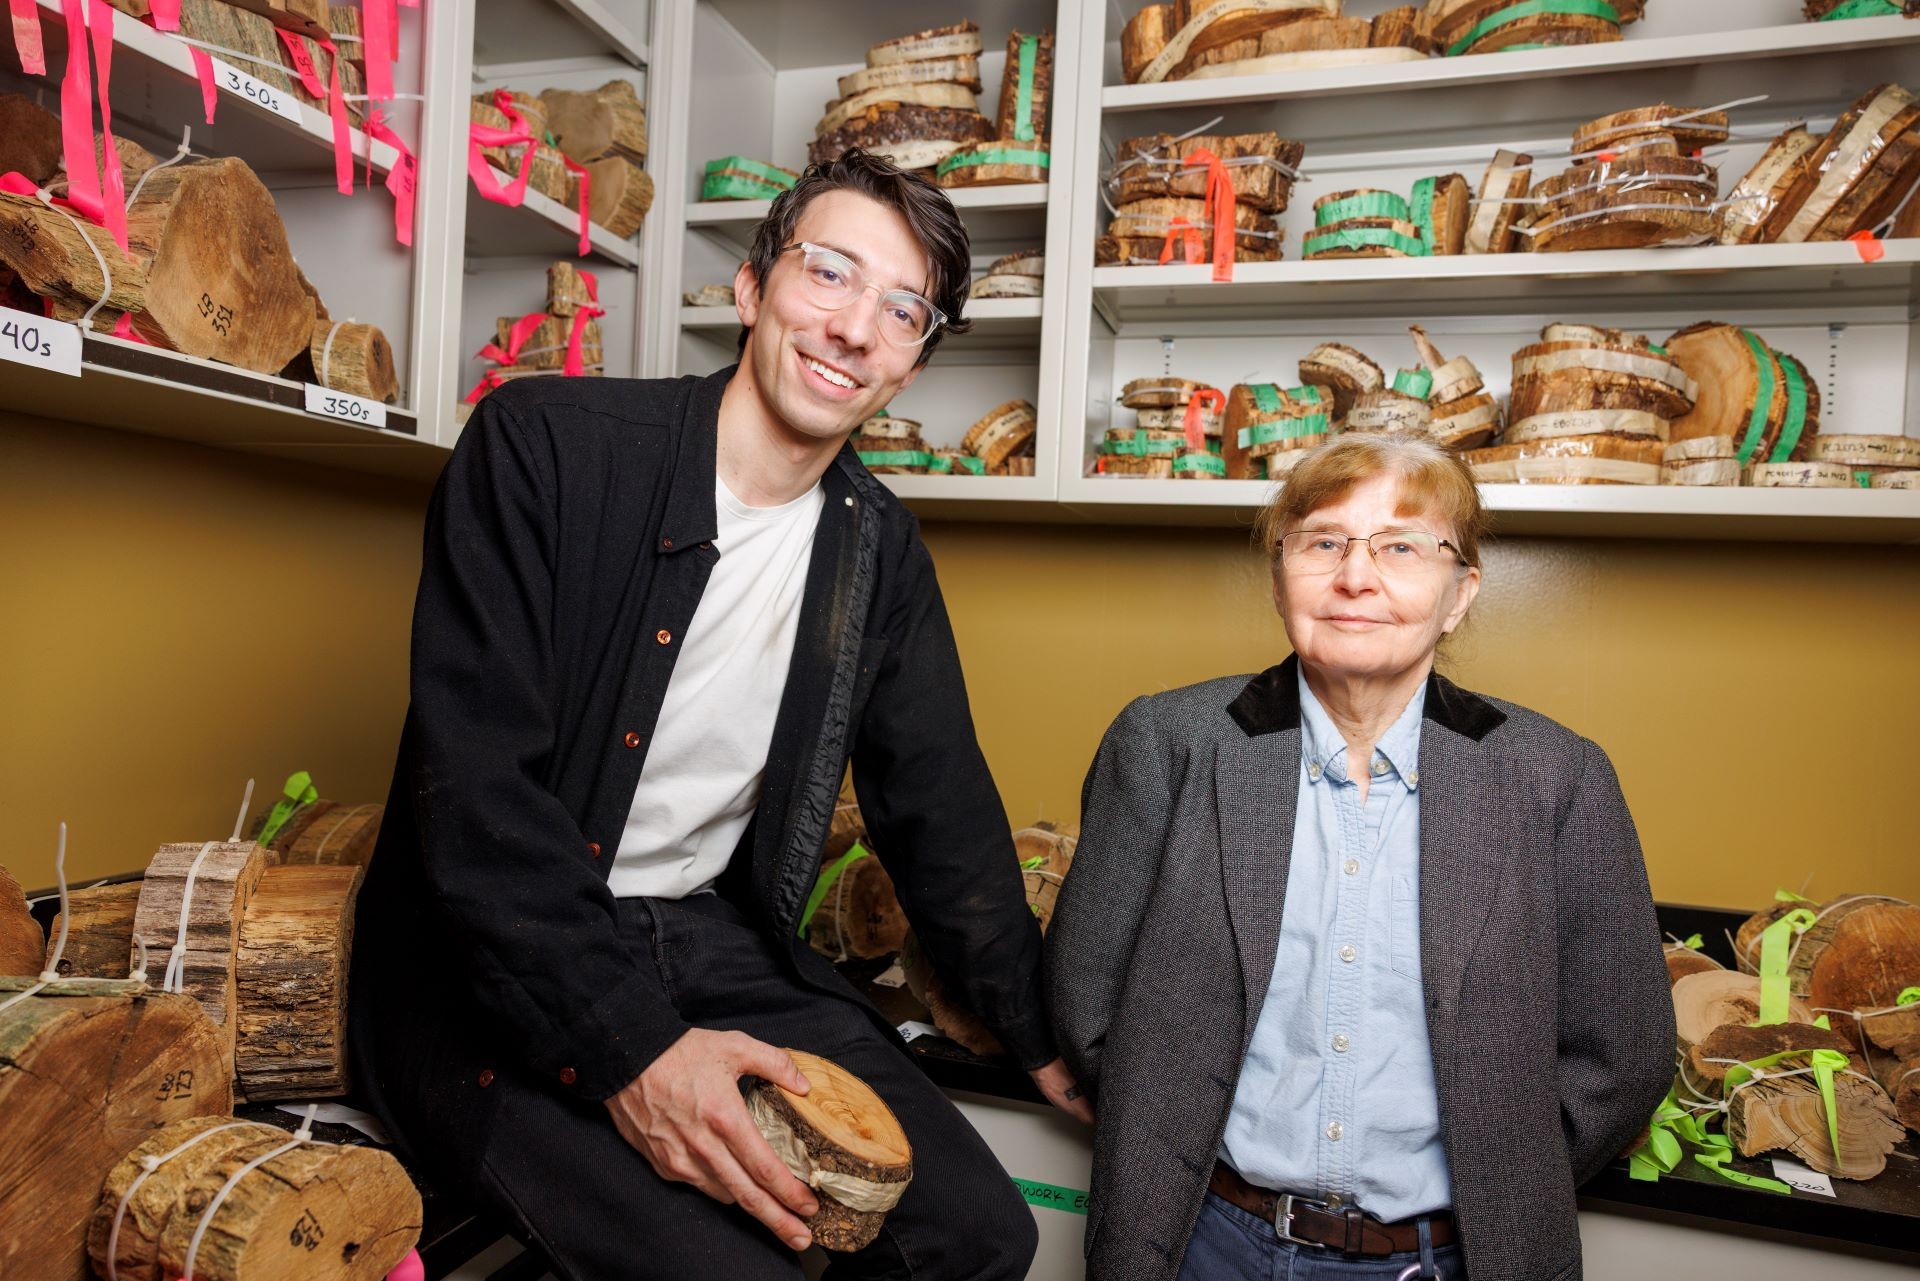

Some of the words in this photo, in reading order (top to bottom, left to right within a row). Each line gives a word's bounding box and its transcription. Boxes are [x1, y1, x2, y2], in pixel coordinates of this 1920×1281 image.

[226, 71, 280, 111] 360s
[24, 217, 40, 235] LB
[197, 292, 215, 318] LB
[211, 304, 233, 337] 351
[323, 396, 370, 420] 350s
